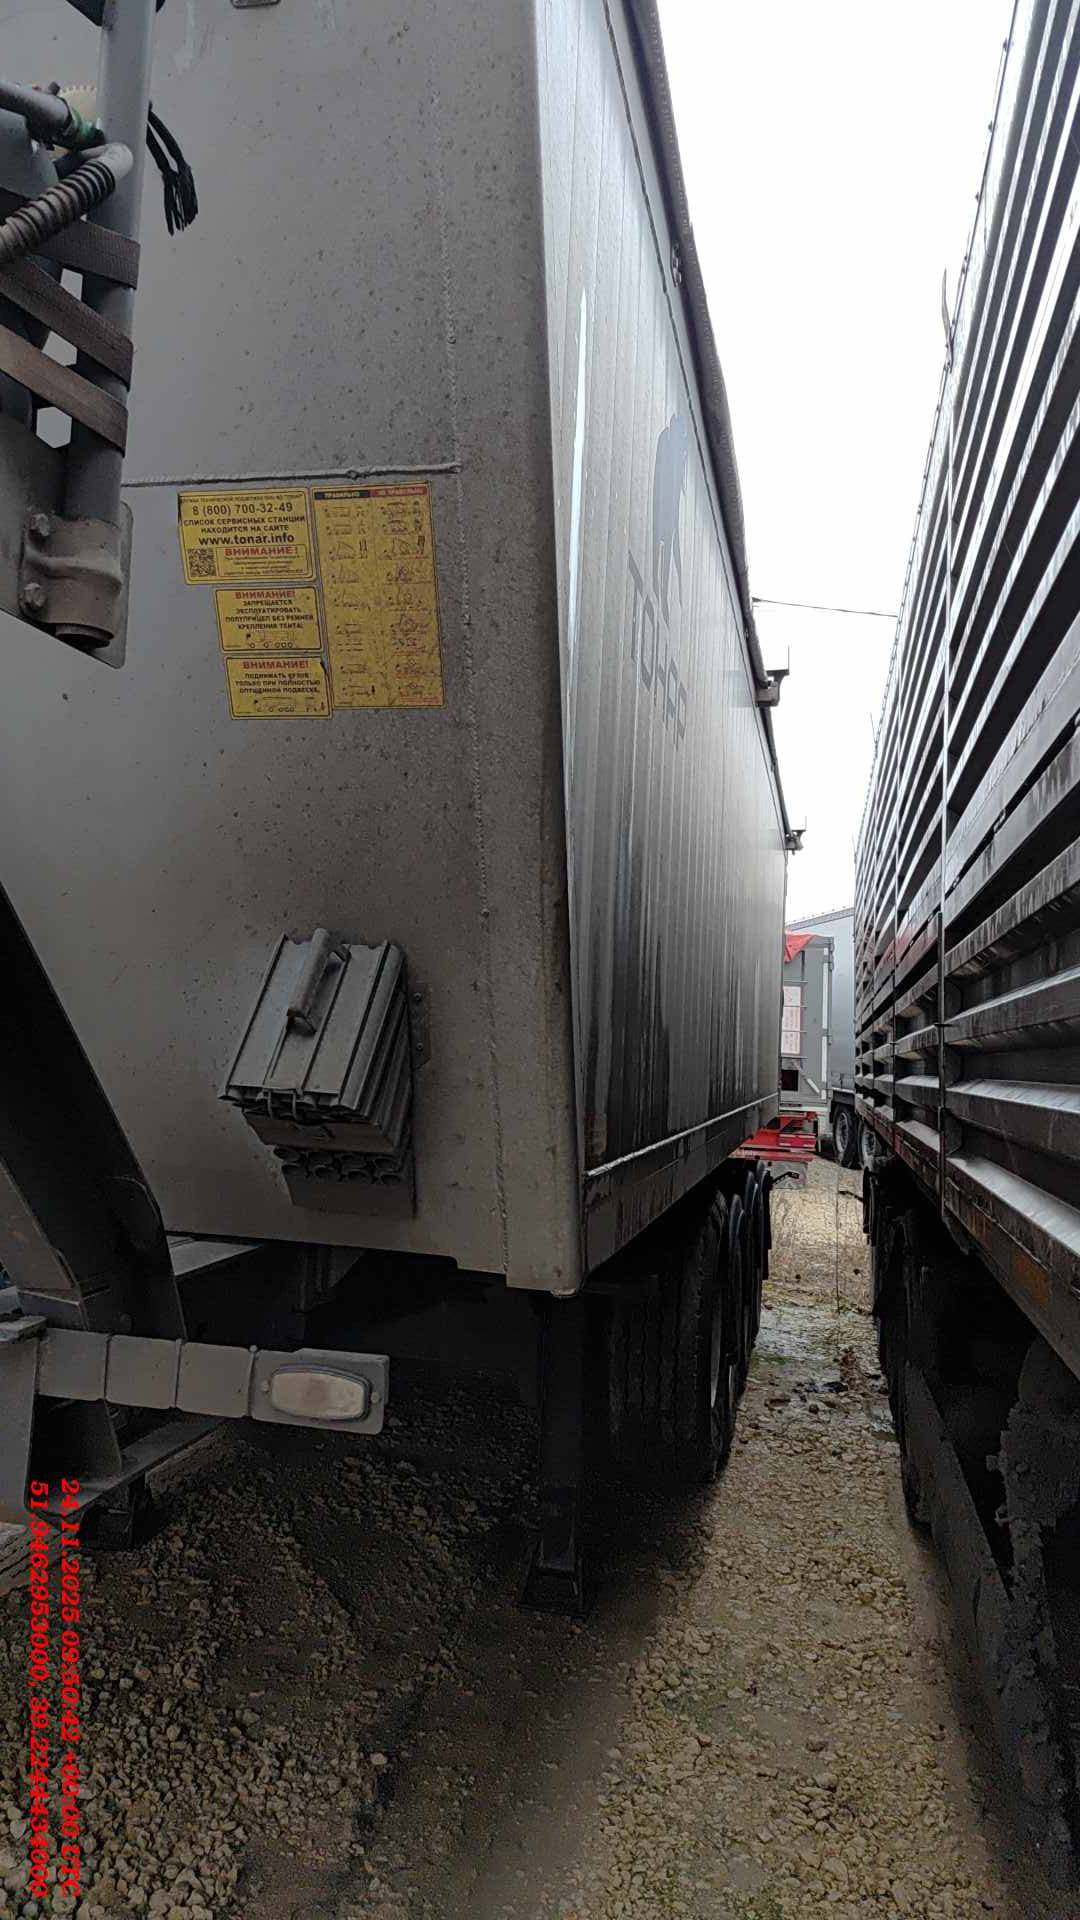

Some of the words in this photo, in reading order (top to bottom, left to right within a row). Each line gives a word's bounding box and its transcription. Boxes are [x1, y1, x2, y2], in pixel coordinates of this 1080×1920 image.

[192, 504, 199, 516] 8
[203, 504, 232, 517] (800)
[236, 502, 294, 514] 700-32-49
[184, 519, 215, 527] СПИСОК
[217, 517, 266, 526] СЕРВИСНЫХ
[201, 526, 248, 534] НАХОДИТСЯ
[198, 532, 295, 546] www.tonar.info
[224, 546, 298, 557] ВНИМАНИЕ!
[235, 590, 296, 599] ВНИМАНИЕ!
[243, 660, 309, 669] ВНИМАНИЕ!
